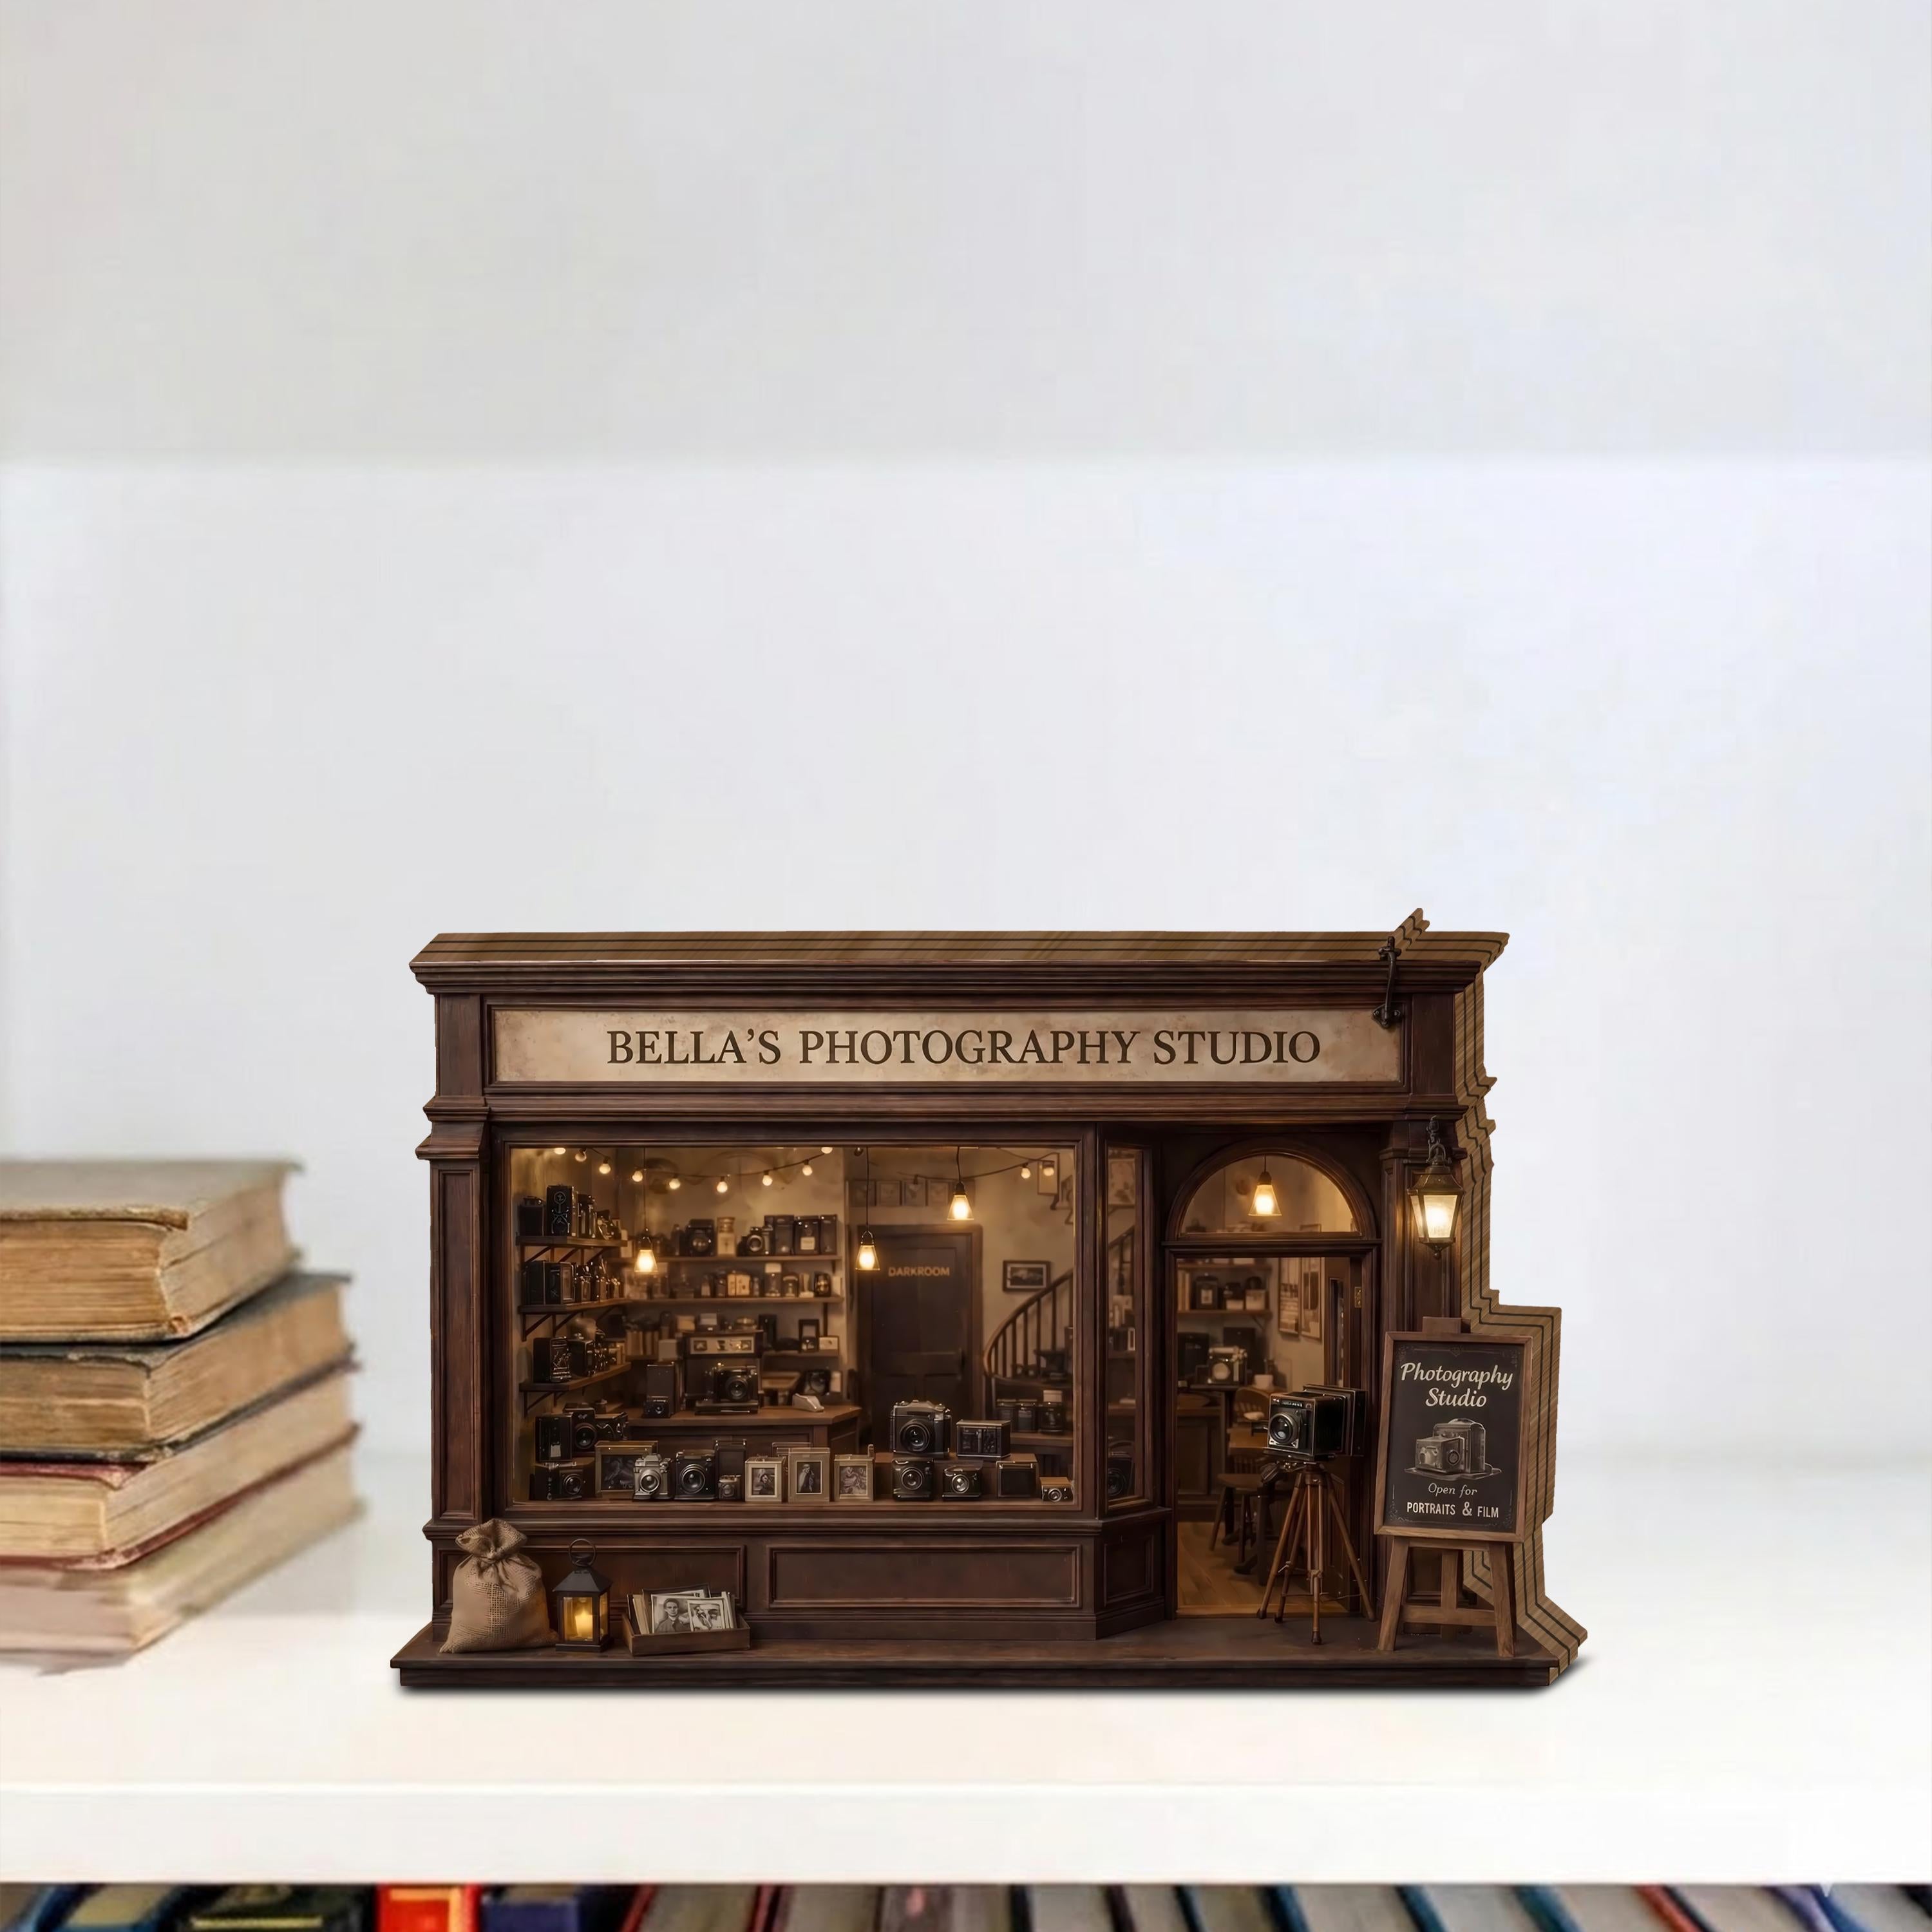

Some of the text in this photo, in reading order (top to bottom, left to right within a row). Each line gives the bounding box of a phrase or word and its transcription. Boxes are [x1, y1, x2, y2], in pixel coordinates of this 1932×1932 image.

[607, 1028, 1321, 1065] BELLA'S PHOTOGRAPHY STUDIO
[888, 1267, 950, 1277] DARKROOM
[1400, 1362, 1513, 1390] Photography
[1425, 1387, 1487, 1407] Studio
[1428, 1482, 1477, 1498] Open for
[1406, 1501, 1499, 1518] PORTRAITS & FILM
